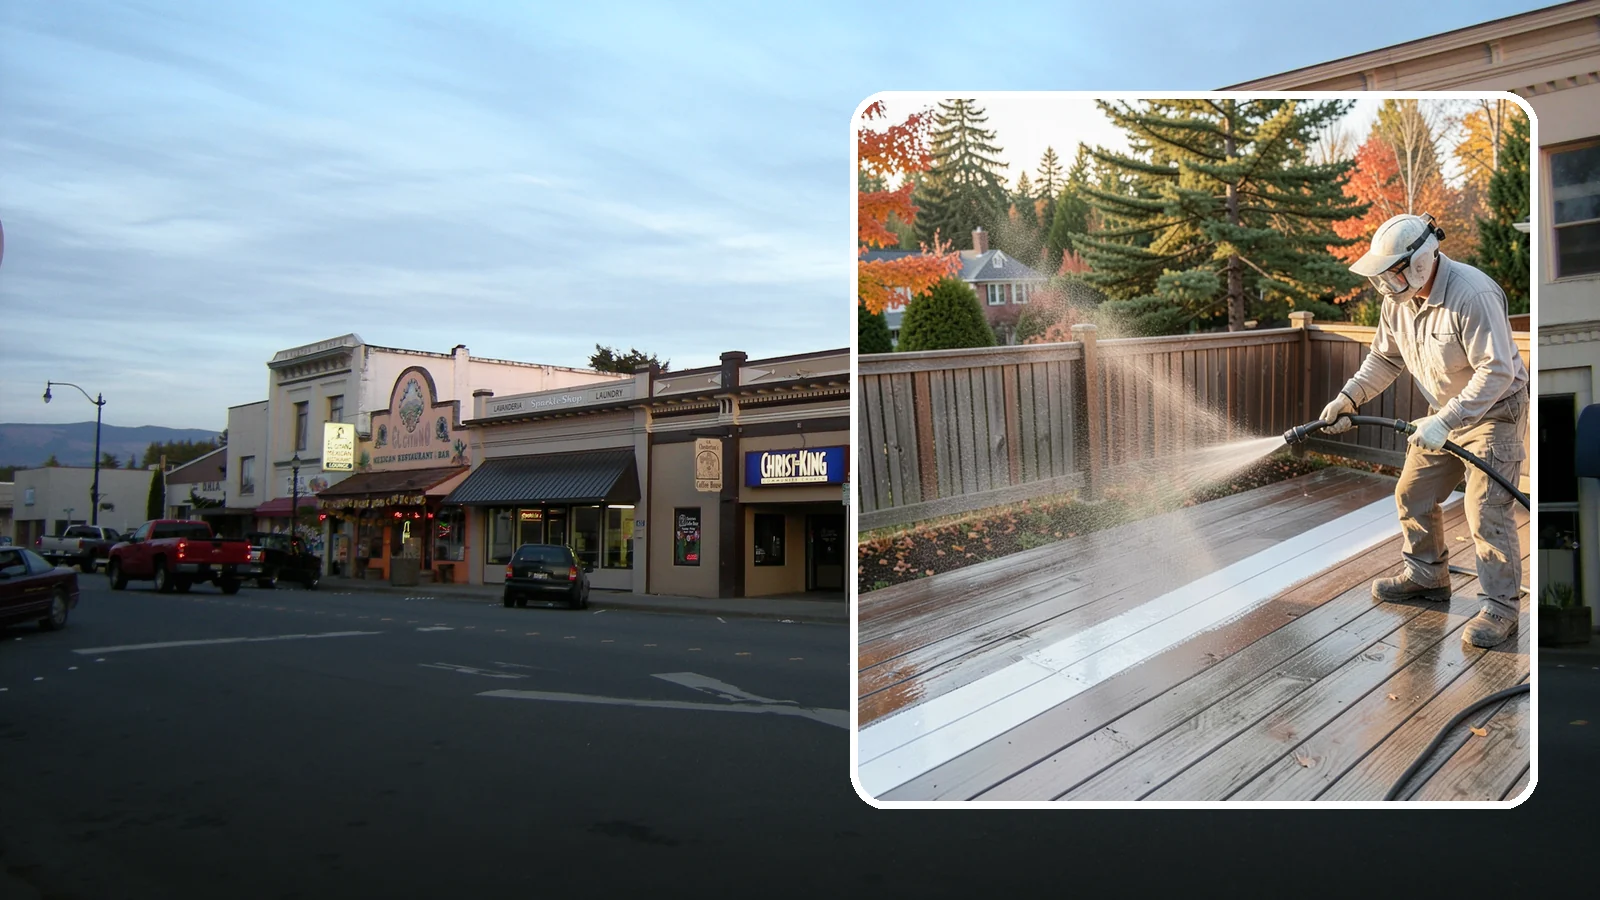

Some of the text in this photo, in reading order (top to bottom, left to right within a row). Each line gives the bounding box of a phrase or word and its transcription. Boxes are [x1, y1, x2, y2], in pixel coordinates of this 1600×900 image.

[494, 389, 623, 412] LAVANDERIA Sparkle Shop LAUNDRY
[374, 455, 396, 464] MEXICAN
[397, 452, 433, 462] RESTAURANT
[438, 450, 450, 459] BAR
[799, 450, 827, 476] KING
[696, 480, 709, 488] Coffee
